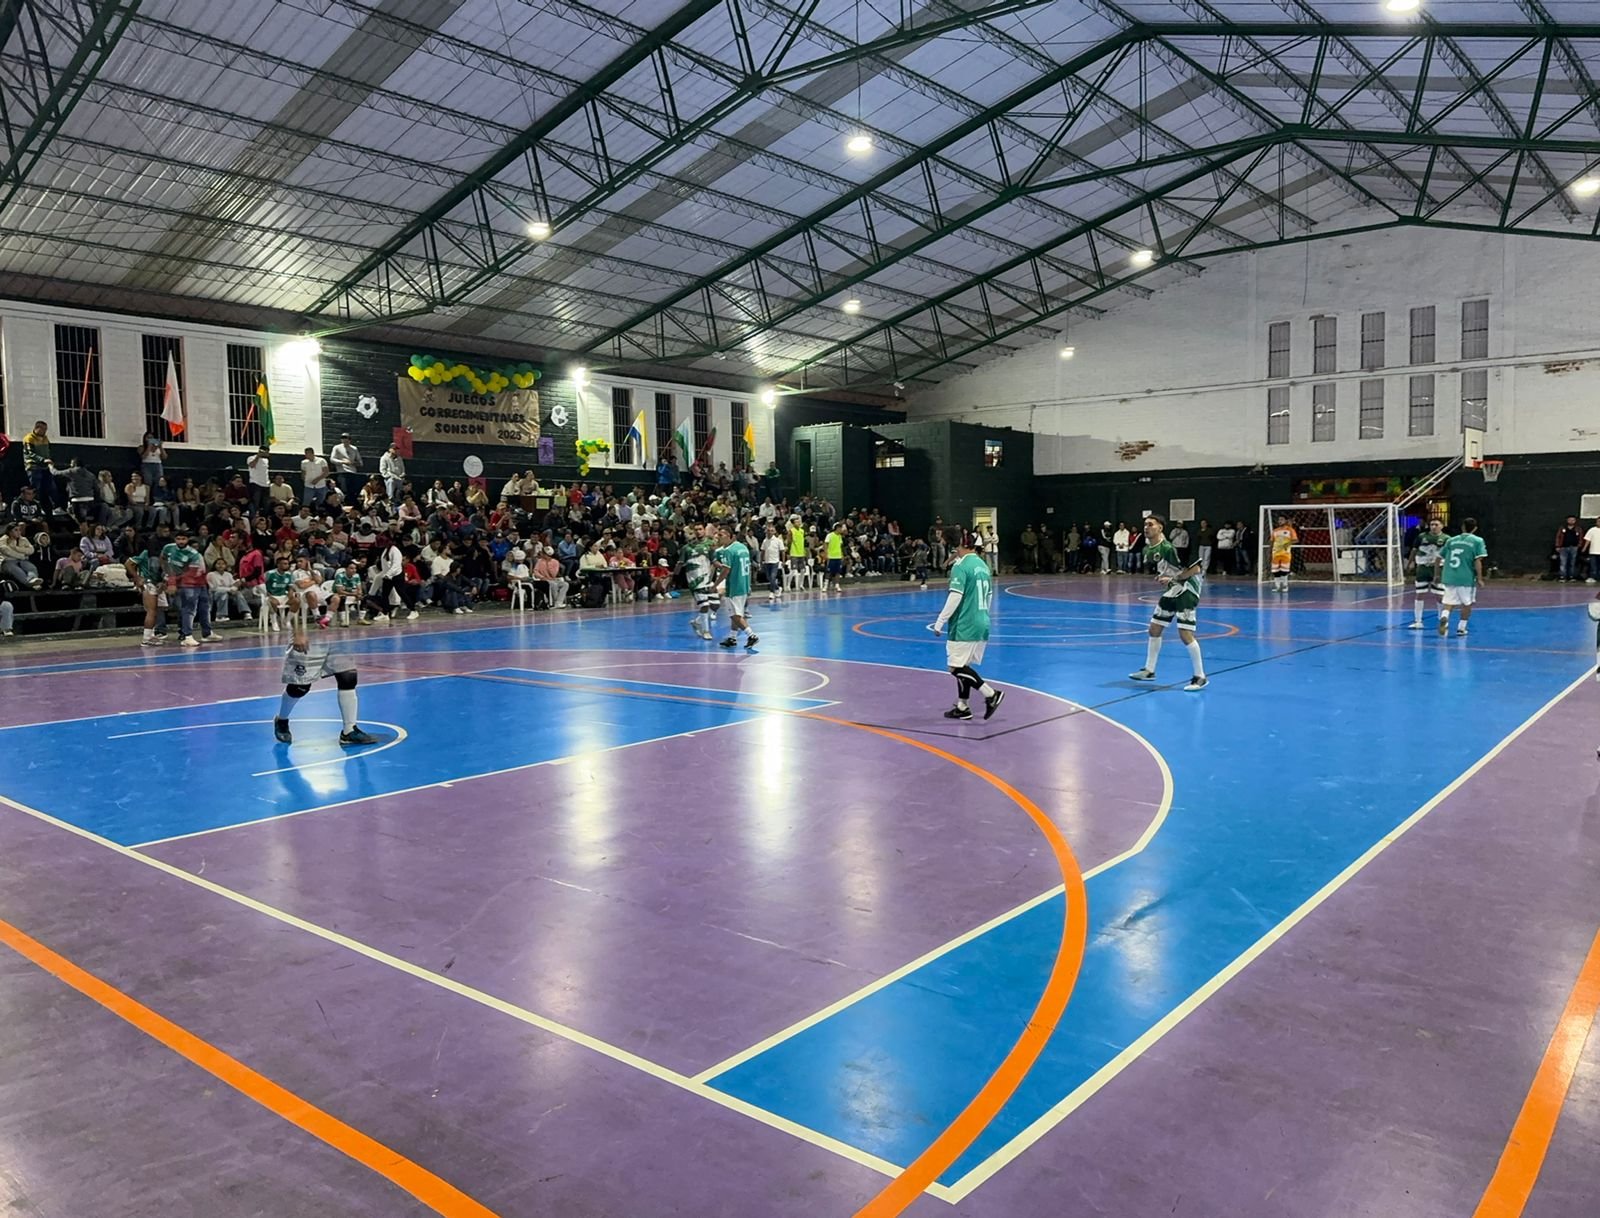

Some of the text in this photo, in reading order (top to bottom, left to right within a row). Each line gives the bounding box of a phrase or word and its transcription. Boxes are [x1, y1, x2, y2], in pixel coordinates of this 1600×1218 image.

[448, 392, 495, 406] JUEGOS
[420, 406, 524, 423] CORREGIMENTALES
[435, 422, 522, 441] SONSON 2025
[1449, 548, 1464, 568] 5
